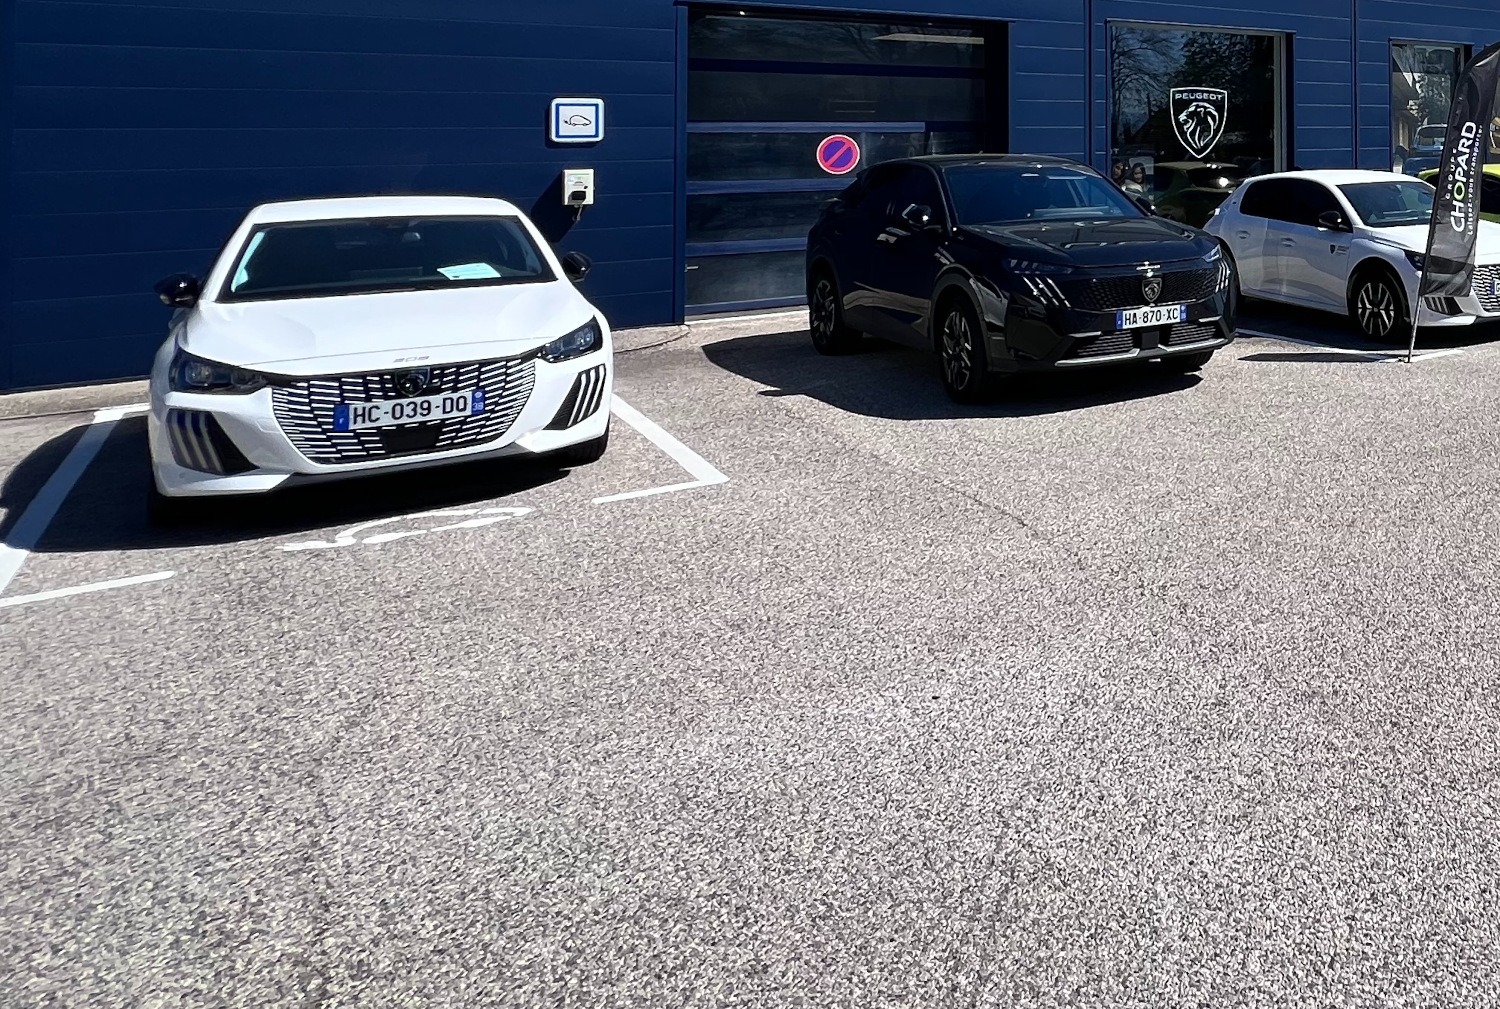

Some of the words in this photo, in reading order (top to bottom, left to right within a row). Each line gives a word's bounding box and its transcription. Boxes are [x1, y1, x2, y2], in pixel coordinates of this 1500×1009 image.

[1175, 92, 1223, 101] PEUGEOT
[1445, 148, 1457, 200] GROUPE
[1450, 121, 1477, 232] CHOPARD
[1124, 307, 1179, 326] HA-870-XC
